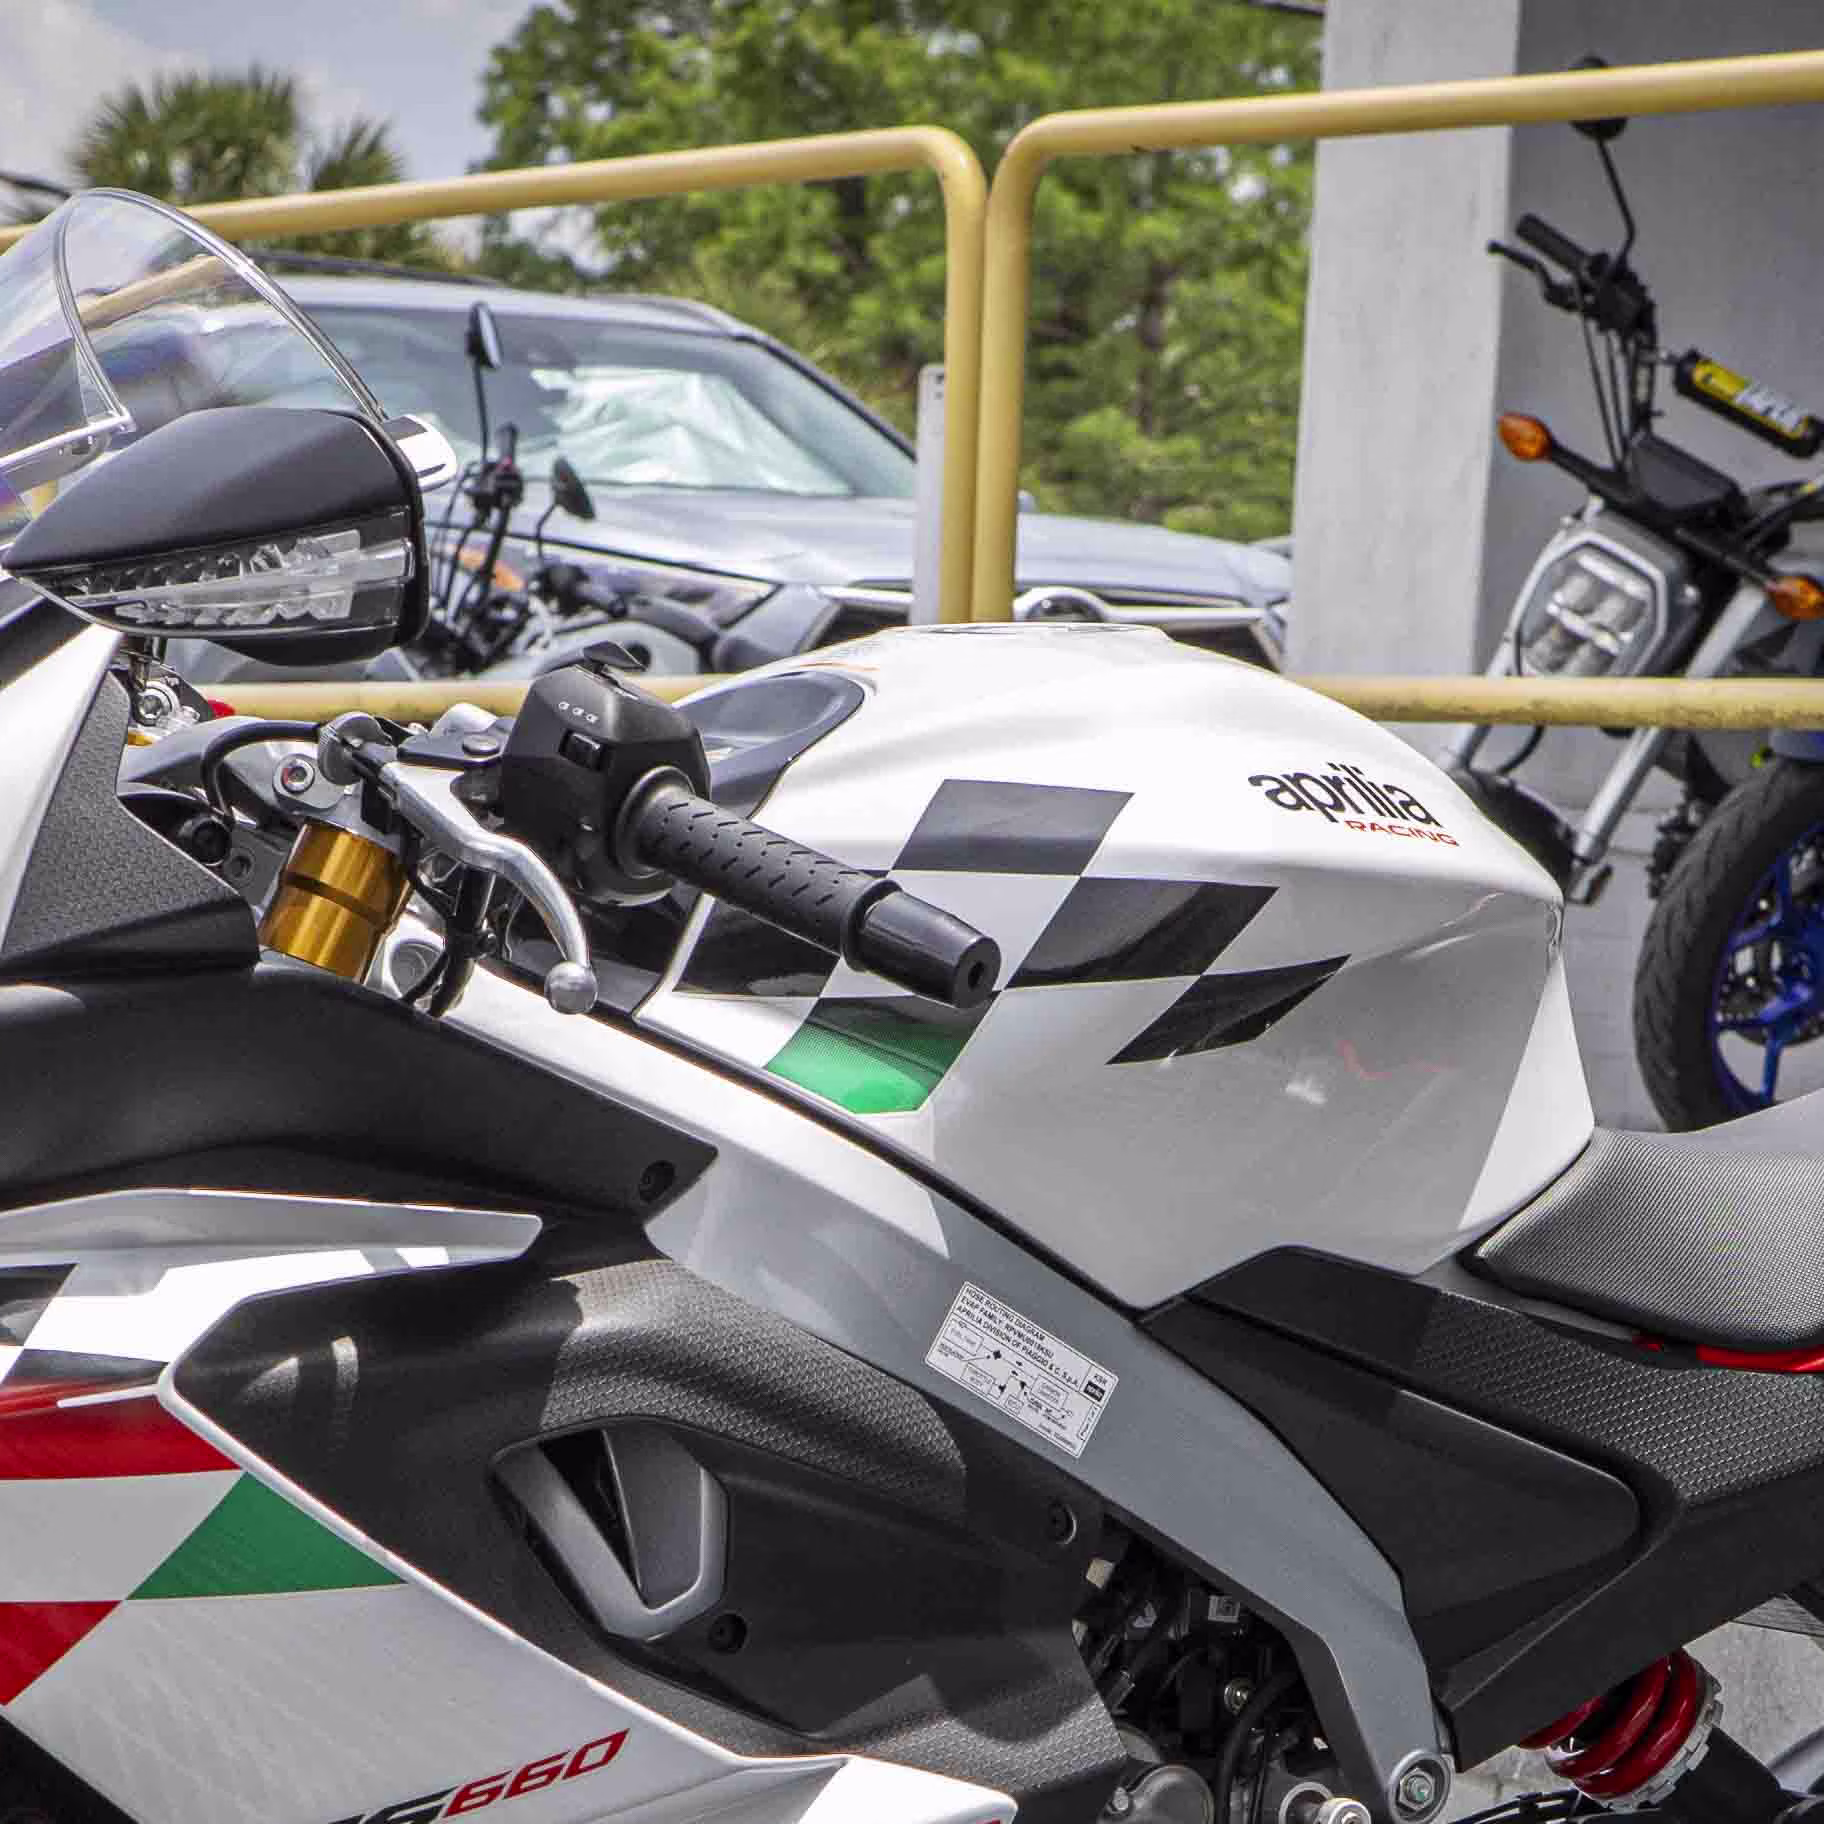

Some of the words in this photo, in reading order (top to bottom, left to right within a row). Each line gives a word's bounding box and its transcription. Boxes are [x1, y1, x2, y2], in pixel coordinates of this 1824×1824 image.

[1248, 762, 1444, 829] aprilia
[1344, 820, 1460, 847] RACING
[956, 1304, 982, 1324] APRILIA
[982, 1321, 1011, 1342] DIVISION
[1011, 1339, 1020, 1348] OF
[1021, 1345, 1049, 1366] PIAGGIO
[1014, 1319, 1045, 1341] DIAGRAM
